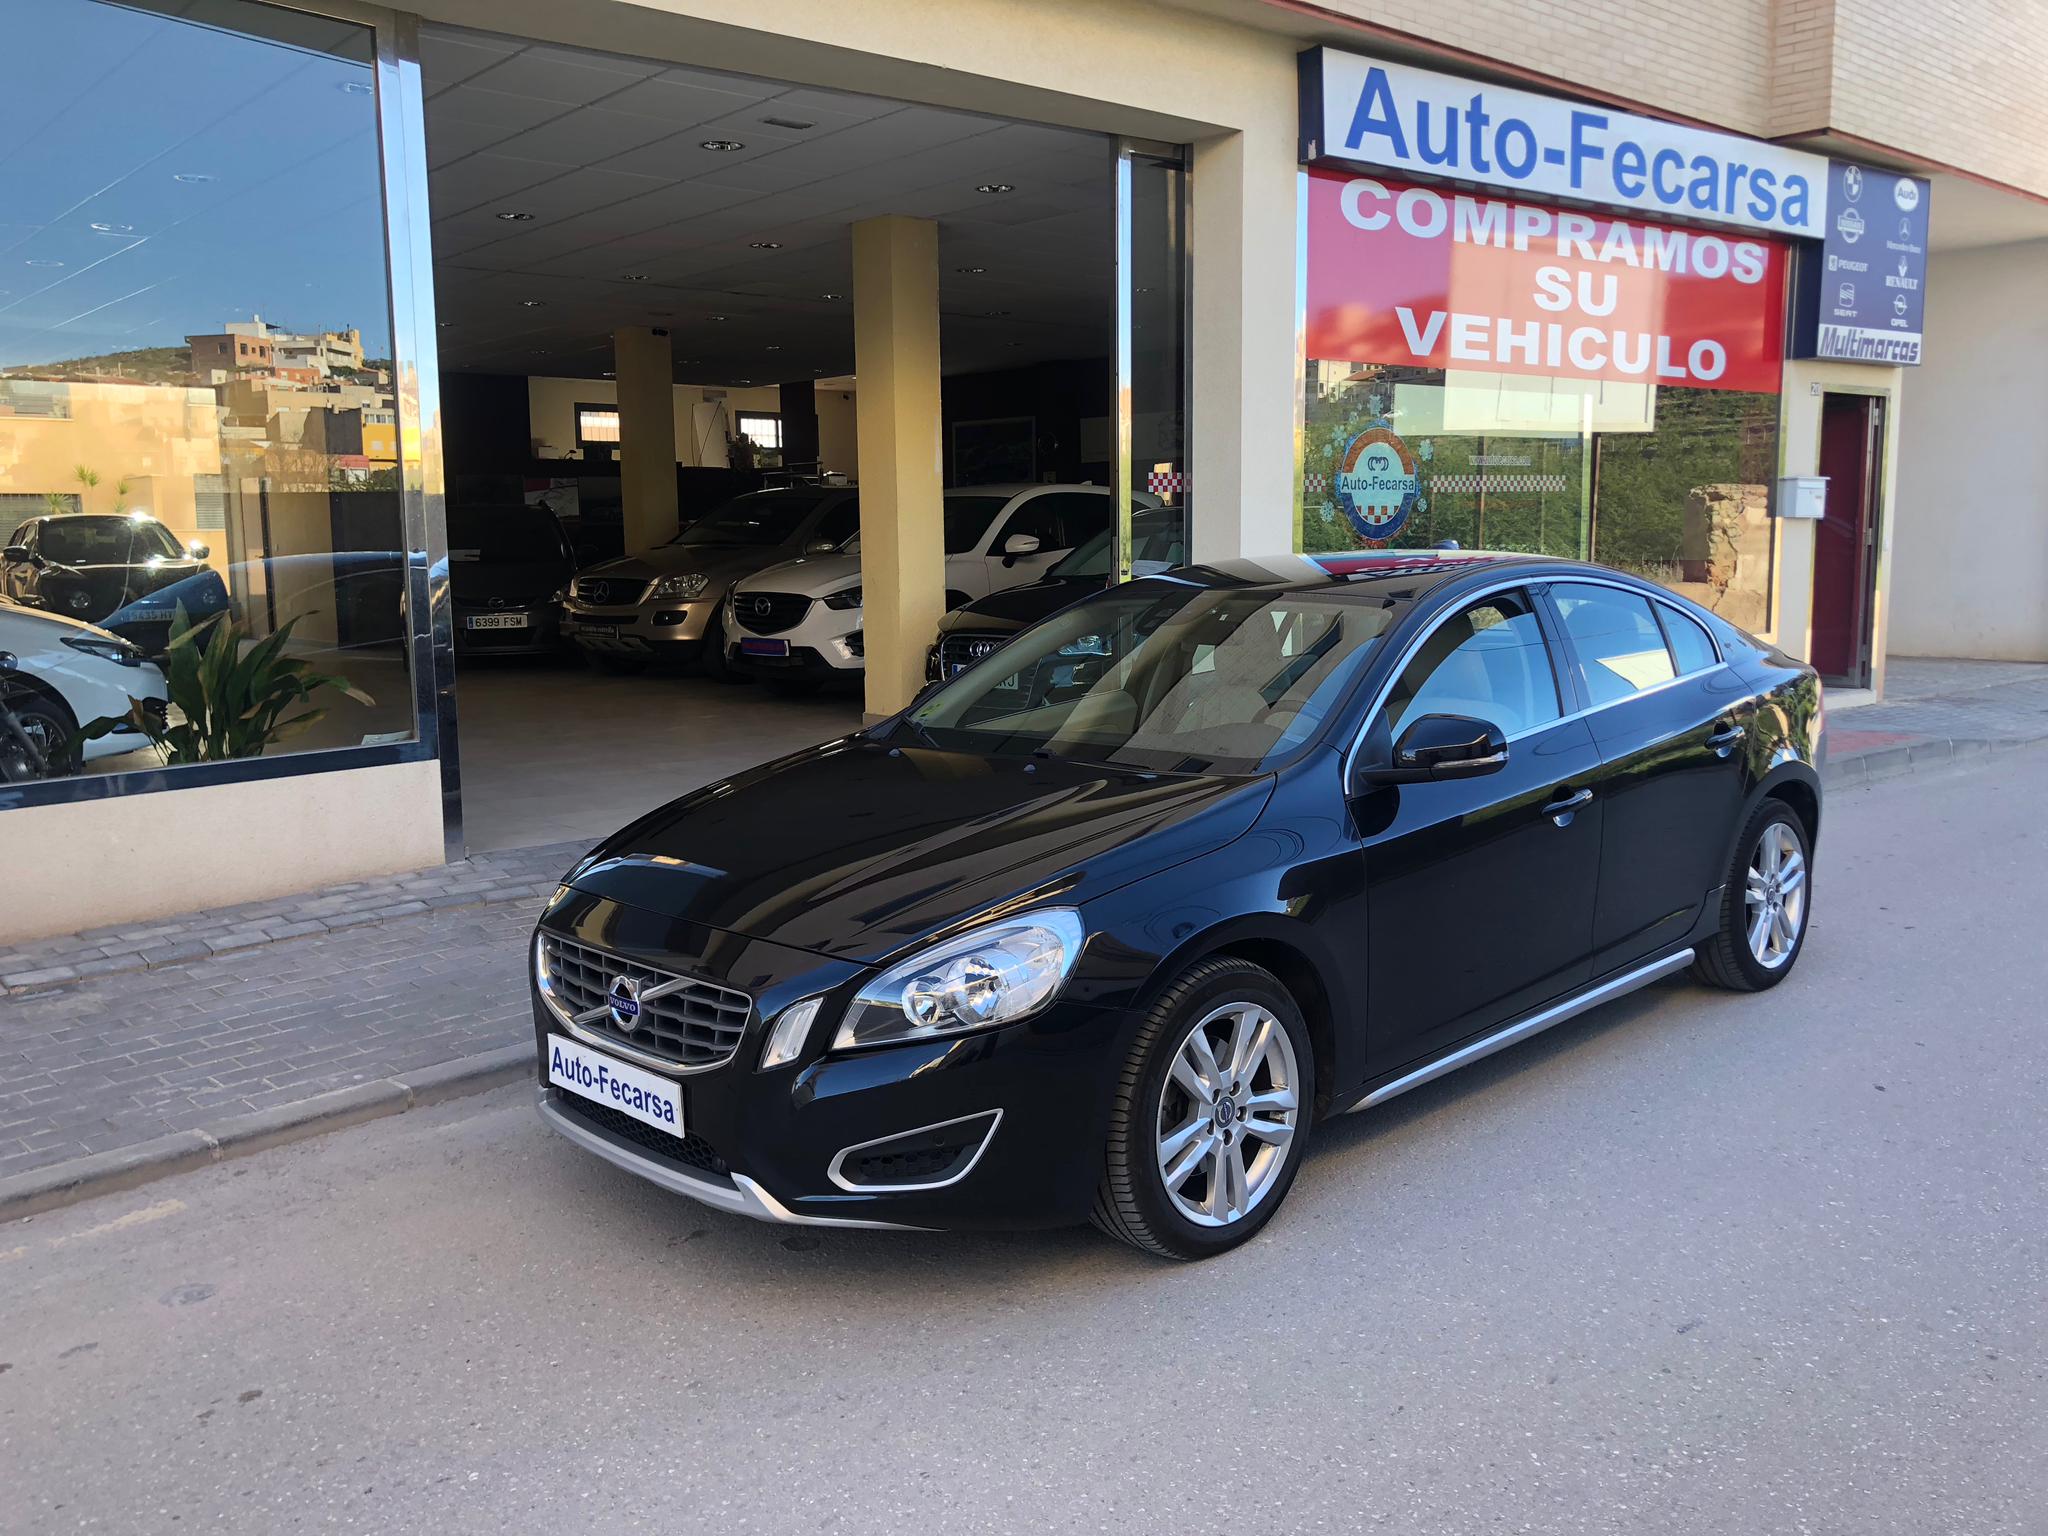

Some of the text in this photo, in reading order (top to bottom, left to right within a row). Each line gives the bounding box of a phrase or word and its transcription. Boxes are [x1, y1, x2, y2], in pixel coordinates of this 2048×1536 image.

[1345, 67, 1809, 227] Auto-Fecarsa
[1340, 179, 1764, 284] COMPRAMOS
[1533, 266, 1618, 317] SU
[1885, 275, 1918, 290] RENAULT
[1833, 308, 1858, 317] SEAT
[1890, 318, 1909, 328] OPEL
[1395, 306, 1726, 381] VEHICULO
[1820, 326, 1920, 362] Multimarcas
[1341, 475, 1415, 492] Auto-Fecarsa
[475, 616, 523, 628] 6399 FSM
[609, 995, 637, 1013] VOLVO
[551, 1046, 675, 1125] Auto-Fecarsa
